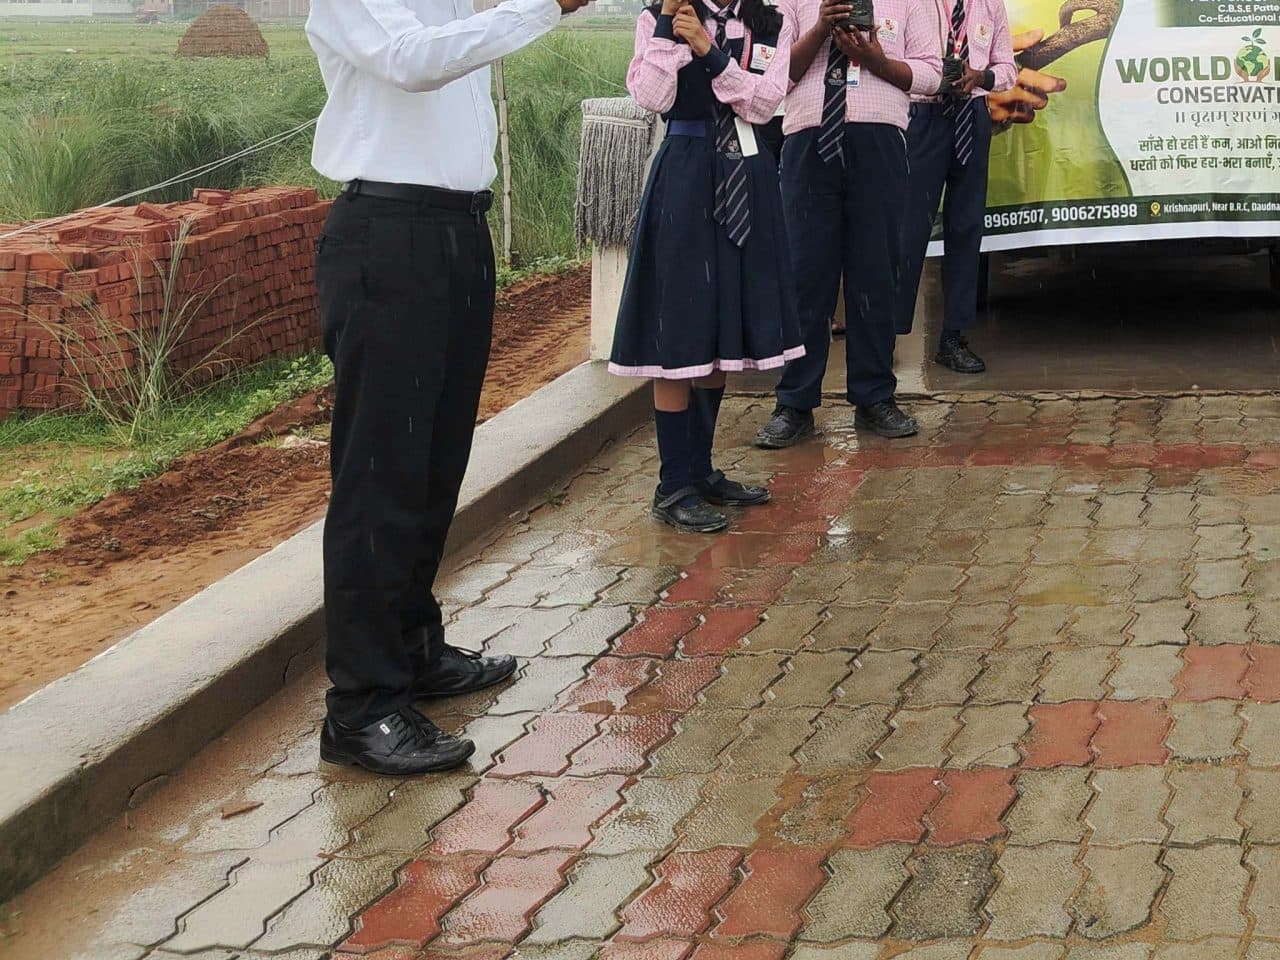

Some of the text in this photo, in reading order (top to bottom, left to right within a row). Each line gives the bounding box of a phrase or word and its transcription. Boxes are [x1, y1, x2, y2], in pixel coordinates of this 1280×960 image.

[1218, 4, 1251, 13] C.B.S.E
[1198, 14, 1276, 23] Co-Educational
[1115, 55, 1231, 84] WORLD
[1166, 136, 1177, 150] हो
[1180, 135, 1198, 149] रही
[1212, 137, 1233, 151] कम,
[1236, 135, 1262, 149] आओ
[1130, 156, 1157, 171] धरती
[1160, 155, 1173, 169] को
[1176, 154, 1198, 169] फिर
[1200, 157, 1243, 169] हरा-भरा
[984, 203, 1138, 228] 89687507, 9006275898
[1163, 202, 1211, 214] Krishnapuri,
[1212, 203, 1228, 212] Near
